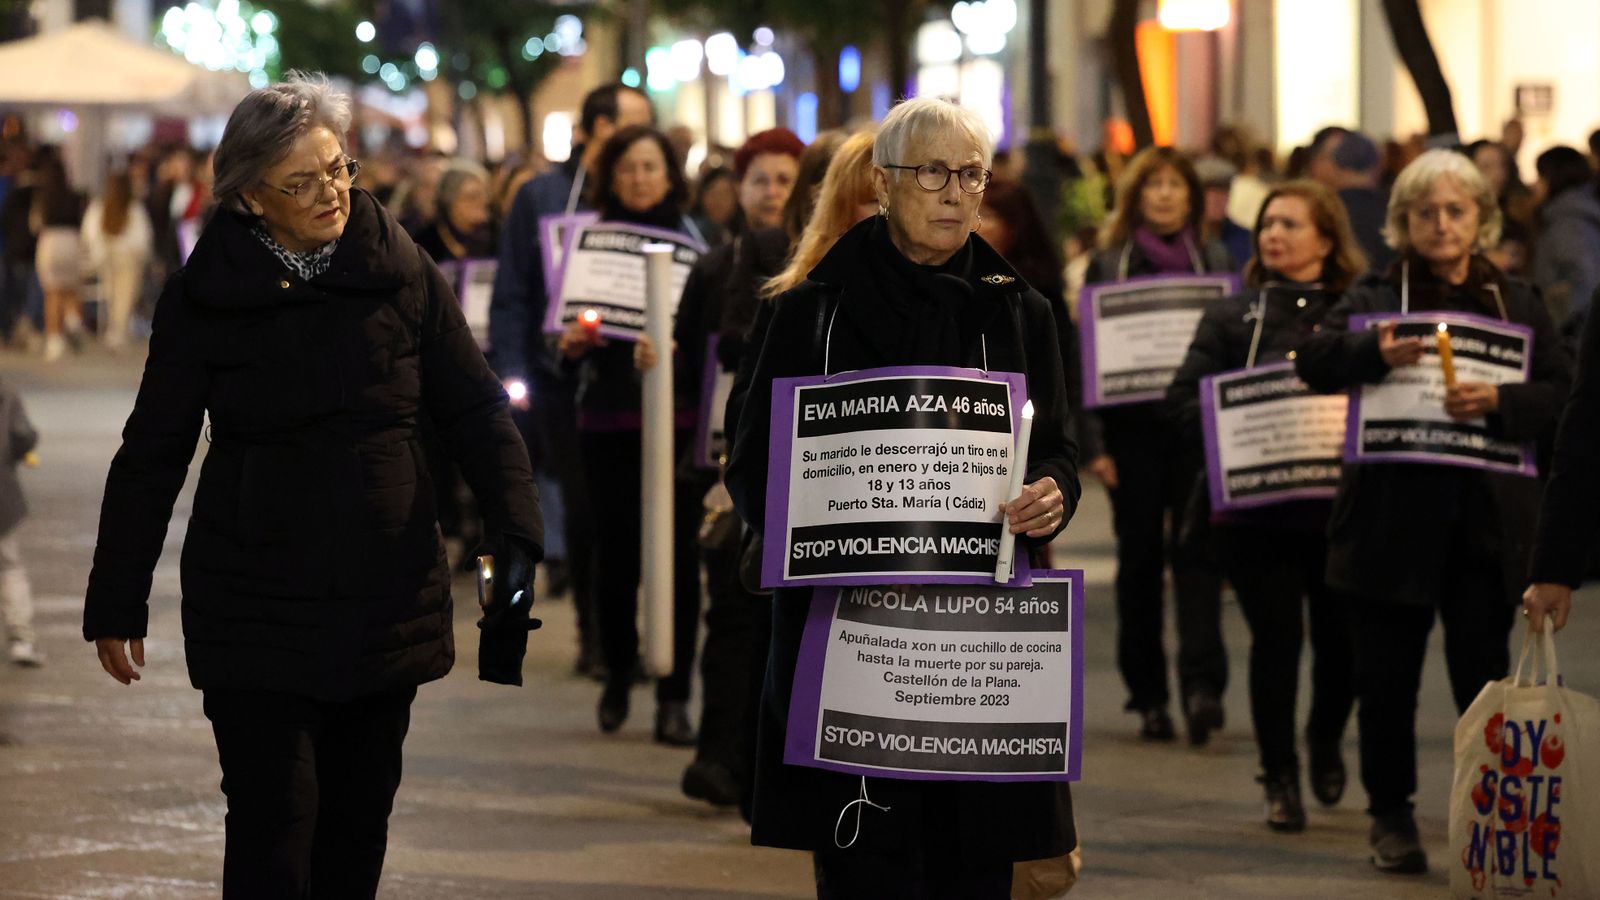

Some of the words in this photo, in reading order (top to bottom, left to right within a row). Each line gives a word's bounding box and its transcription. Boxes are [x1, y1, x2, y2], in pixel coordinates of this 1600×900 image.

[804, 403, 835, 421] EVA
[841, 396, 900, 416] MARIA
[906, 395, 947, 412] AZA
[952, 396, 970, 413] 46
[974, 398, 1005, 416] años
[802, 450, 817, 462] Su
[820, 447, 857, 460] marido
[861, 444, 872, 457] le
[875, 443, 947, 458] descerrajó
[951, 446, 964, 455] un
[968, 445, 984, 456] tiro
[986, 449, 997, 457] en
[1000, 447, 1008, 458] el
[803, 464, 855, 480] domicilio,
[859, 464, 874, 473] en
[878, 462, 917, 473] enero
[921, 463, 929, 475] y
[933, 461, 959, 476] deja
[963, 462, 969, 473] 2
[972, 462, 994, 476] hijos
[997, 464, 1007, 475] de
[868, 480, 882, 491] 18
[887, 482, 893, 492] y
[899, 479, 914, 490] 13
[919, 479, 950, 491] años
[828, 499, 867, 511] Puerto
[872, 497, 898, 508] Sta.
[902, 497, 941, 508] María
[953, 497, 986, 512] Cádiz)
[793, 539, 835, 559] STOP
[839, 537, 937, 556] VIOLENCIA
[941, 538, 1000, 555] MACHIS
[850, 588, 928, 613] NICOLA
[935, 596, 989, 614] LUPO
[995, 599, 1014, 614] 54
[1019, 598, 1059, 614] años
[839, 630, 907, 650] Apuñalada
[912, 641, 936, 651] xon
[941, 643, 956, 652] un
[961, 641, 1006, 653] cuchillo
[1010, 642, 1022, 653] de
[1026, 642, 1061, 653] cocina
[857, 651, 893, 665] hasta
[898, 655, 909, 666] la
[914, 657, 961, 669] muerte
[965, 660, 984, 671] por
[989, 661, 1003, 670] su
[1006, 660, 1044, 672] pareja.
[884, 671, 947, 686] Castellón
[952, 676, 967, 687] de
[971, 677, 981, 687] la
[985, 677, 1020, 688] Plana.
[895, 690, 976, 707] Septiembre
[981, 694, 1009, 705] 2023
[824, 726, 875, 747] STOP
[878, 732, 978, 755] VIOLENCIA
[982, 738, 1063, 755] MACHISTA
